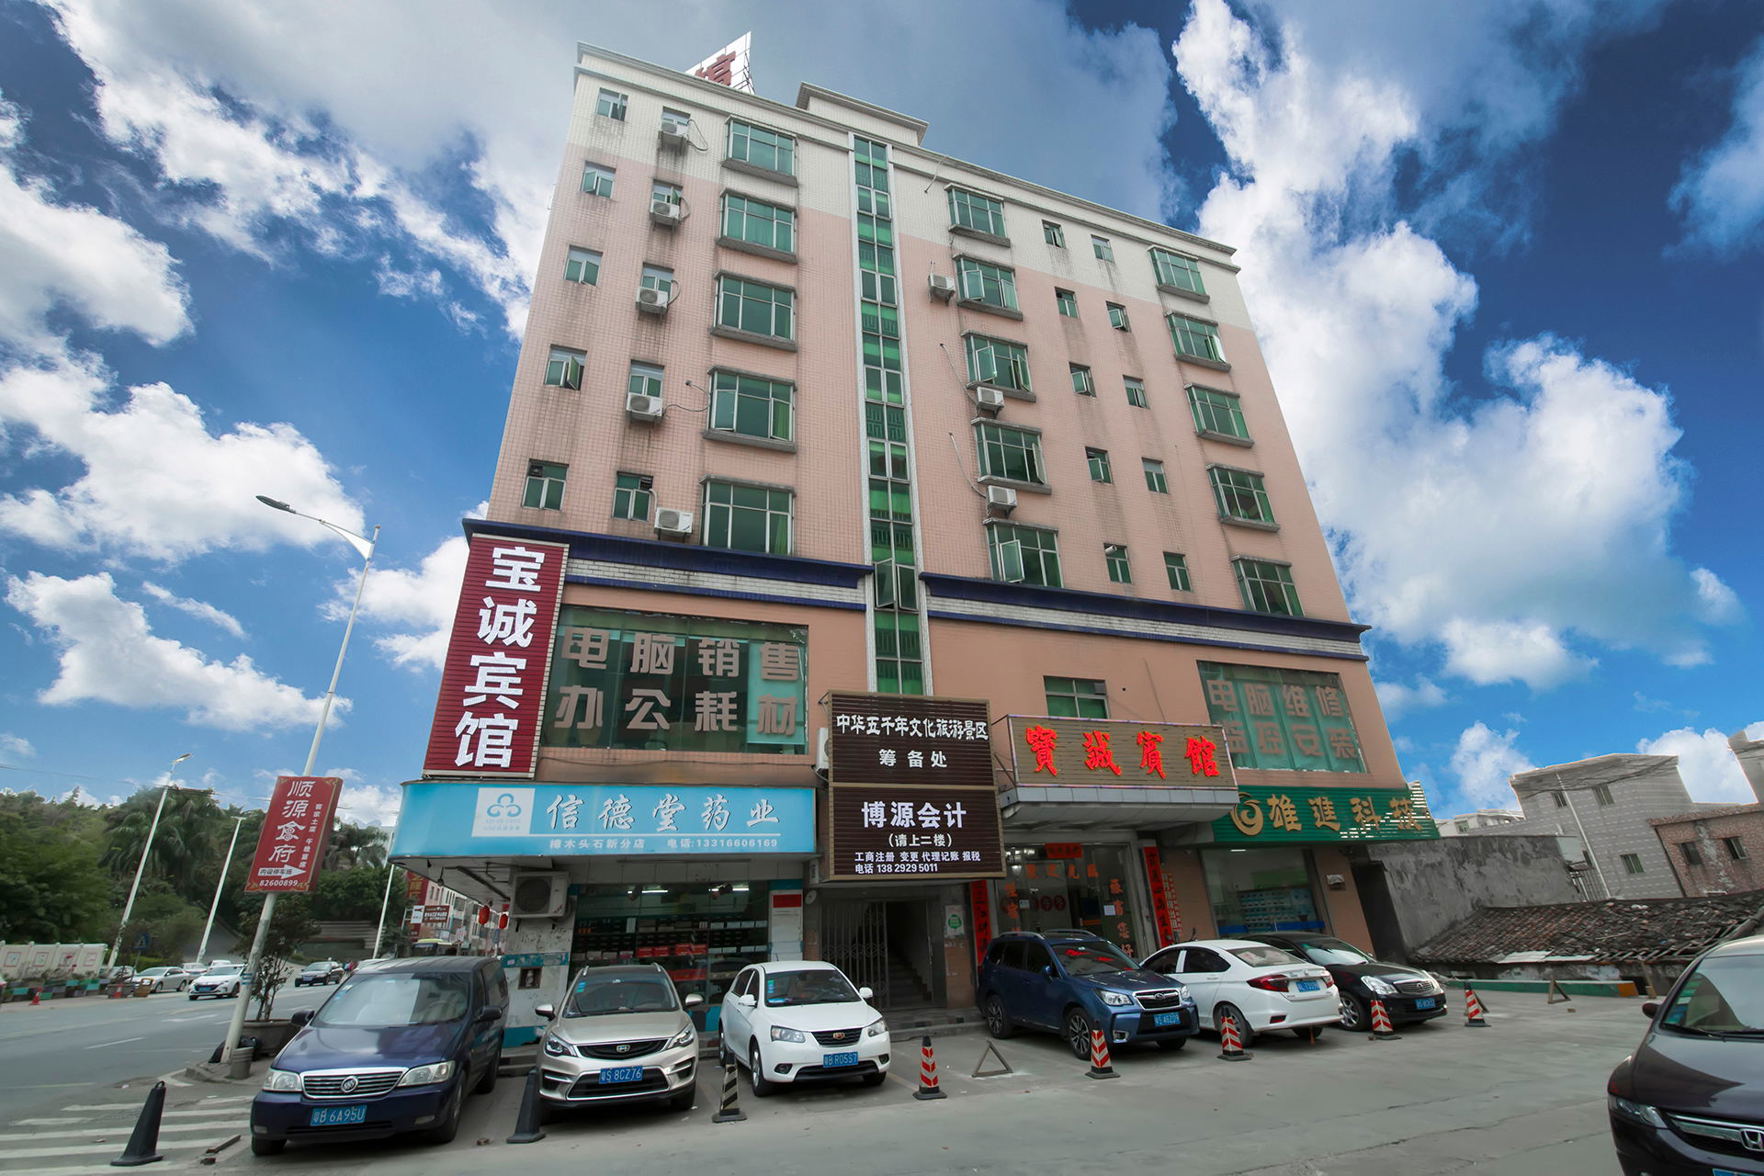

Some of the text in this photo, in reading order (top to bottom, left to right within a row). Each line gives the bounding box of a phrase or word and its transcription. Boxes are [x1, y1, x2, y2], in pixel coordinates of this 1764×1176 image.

[454, 546, 546, 768] 宝诚宾馆
[561, 626, 800, 682] 电脑销售
[555, 687, 799, 737] 办公耗材
[836, 714, 989, 741] 中华五千年文化旅游景区
[878, 749, 947, 769] 筹备处
[268, 781, 316, 863] 顺源食府
[546, 793, 780, 832] 信德堂药业
[861, 801, 967, 828] 博源会计
[855, 851, 895, 862] 工商注册
[922, 851, 959, 862] 代理记账
[855, 863, 938, 874] 电话 138 2929 5011
